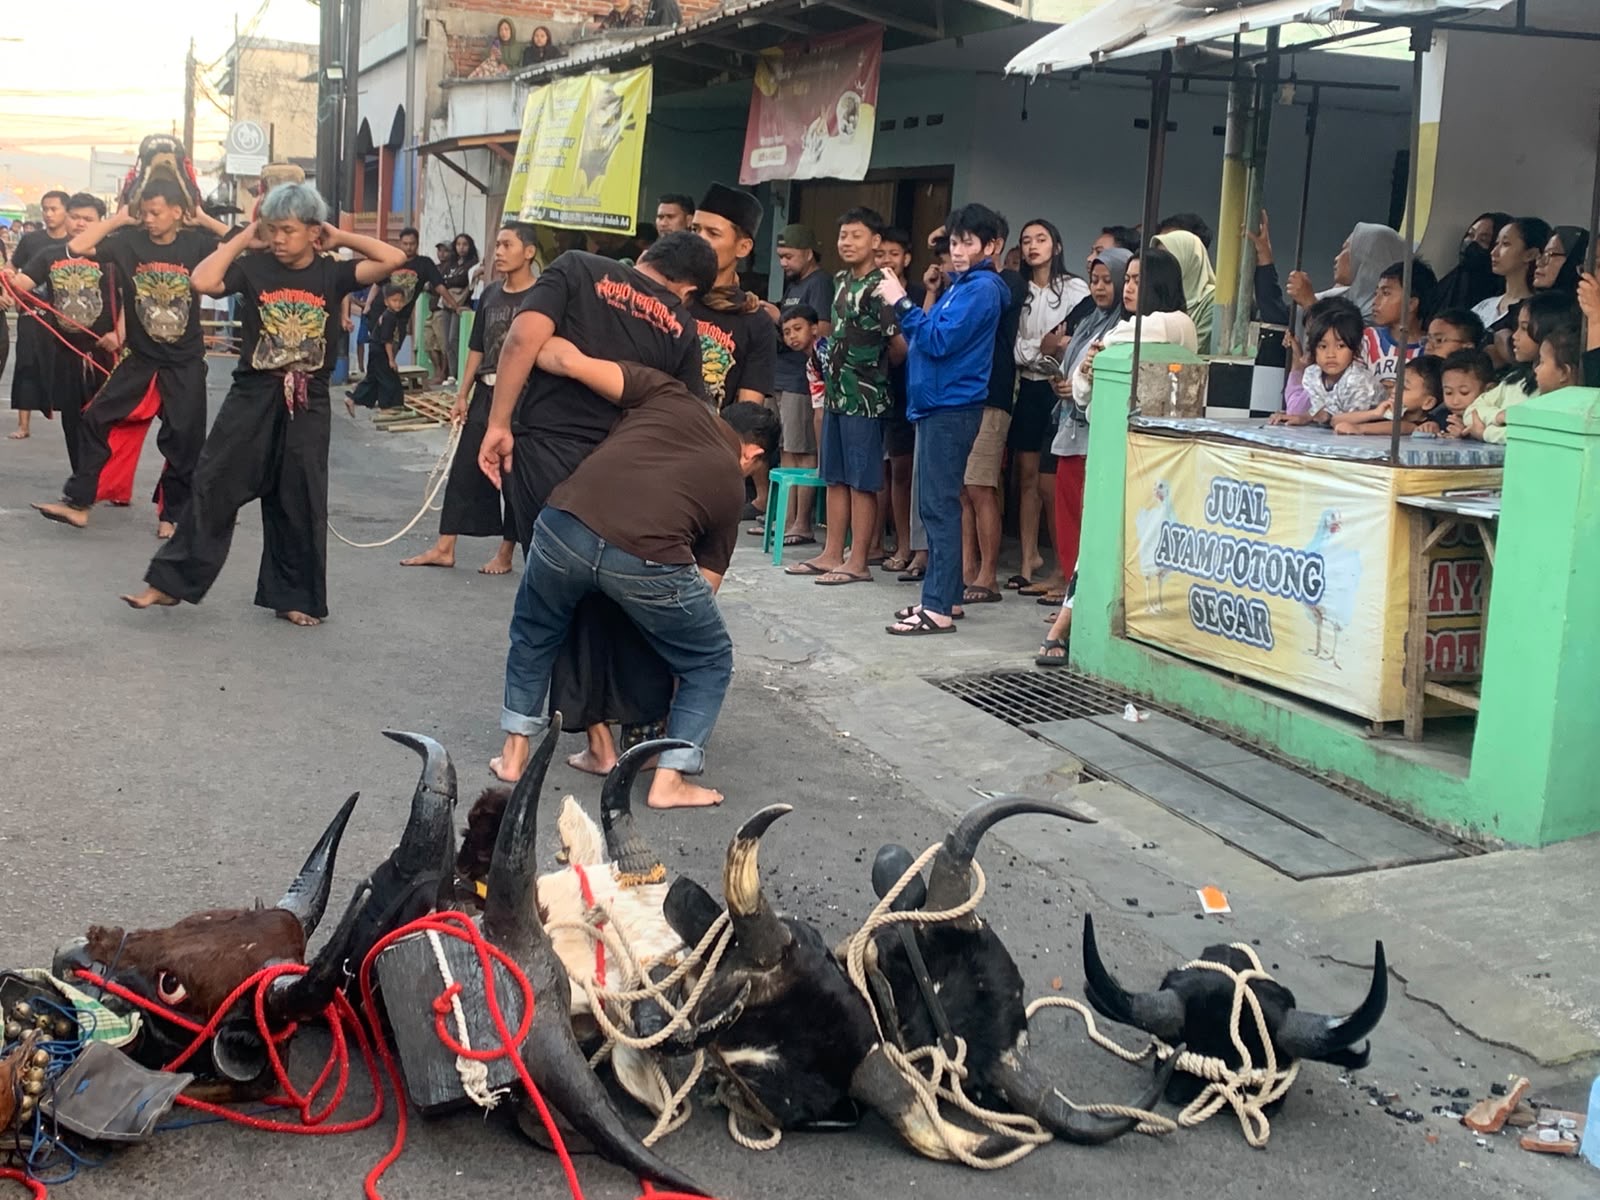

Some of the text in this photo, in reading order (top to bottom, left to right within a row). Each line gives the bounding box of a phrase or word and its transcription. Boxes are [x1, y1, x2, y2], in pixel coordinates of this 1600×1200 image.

[1206, 477, 1269, 533] JUAL
[1156, 523, 1325, 604] AYAM POTONG
[1428, 560, 1482, 614] AY
[1189, 588, 1273, 650] SEGAR
